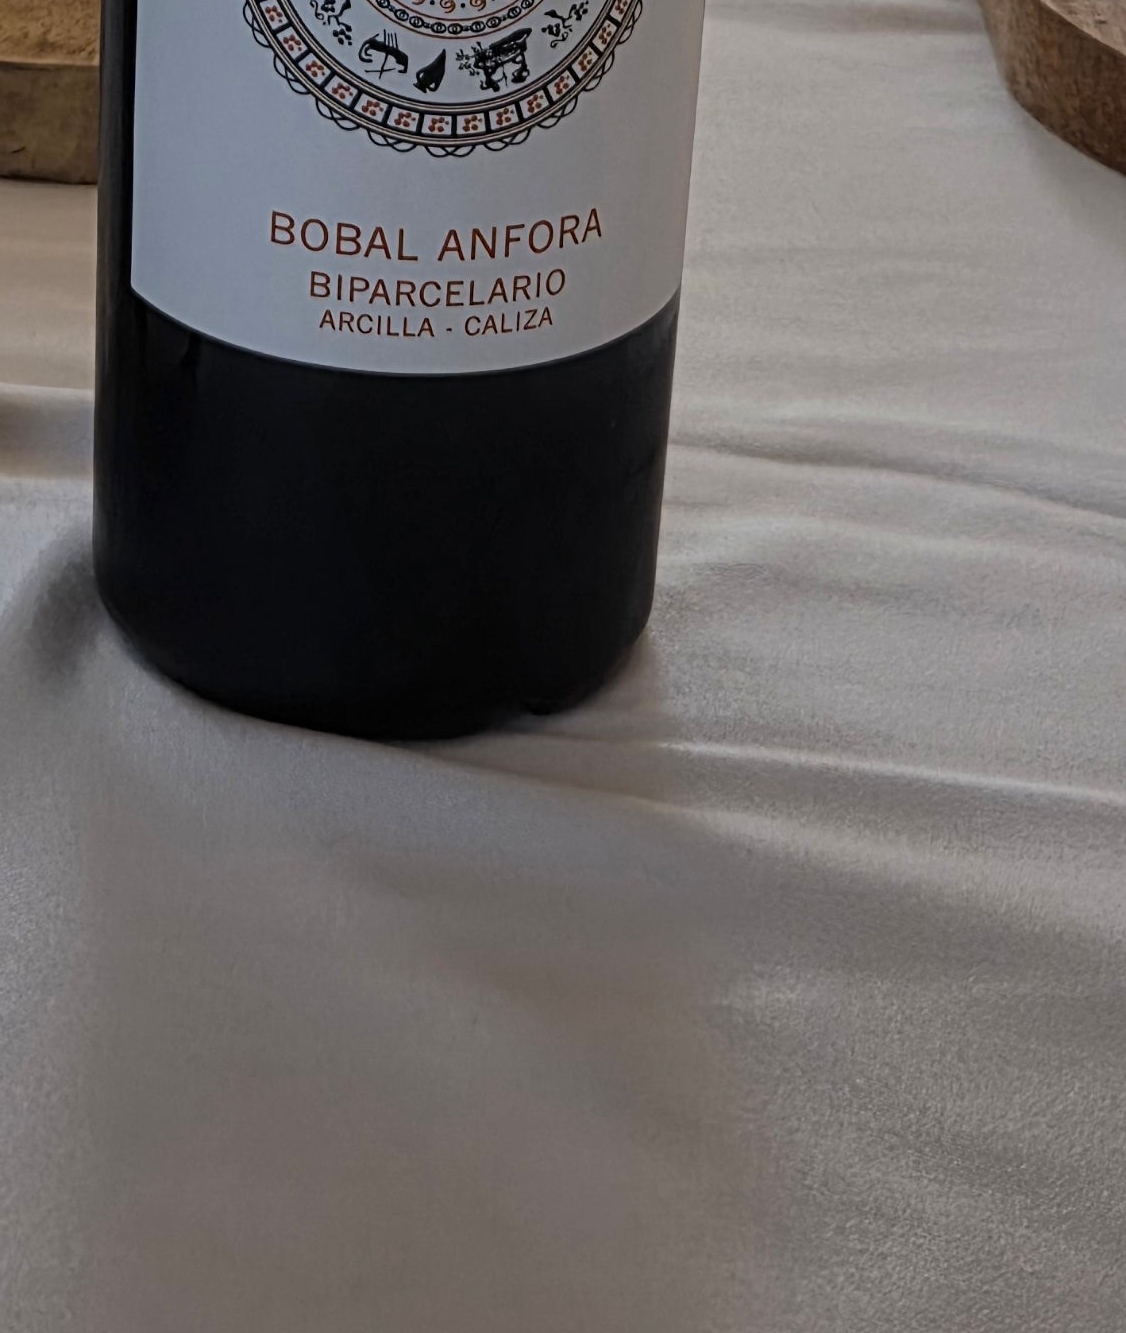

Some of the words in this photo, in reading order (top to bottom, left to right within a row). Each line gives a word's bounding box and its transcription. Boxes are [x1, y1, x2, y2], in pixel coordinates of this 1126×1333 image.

[270, 210, 419, 262] BOBAL
[437, 207, 603, 262] ANFORA
[310, 268, 566, 308] BIPARCELARIO
[319, 309, 435, 337] ARCILLA
[464, 306, 553, 337] CALIZA
